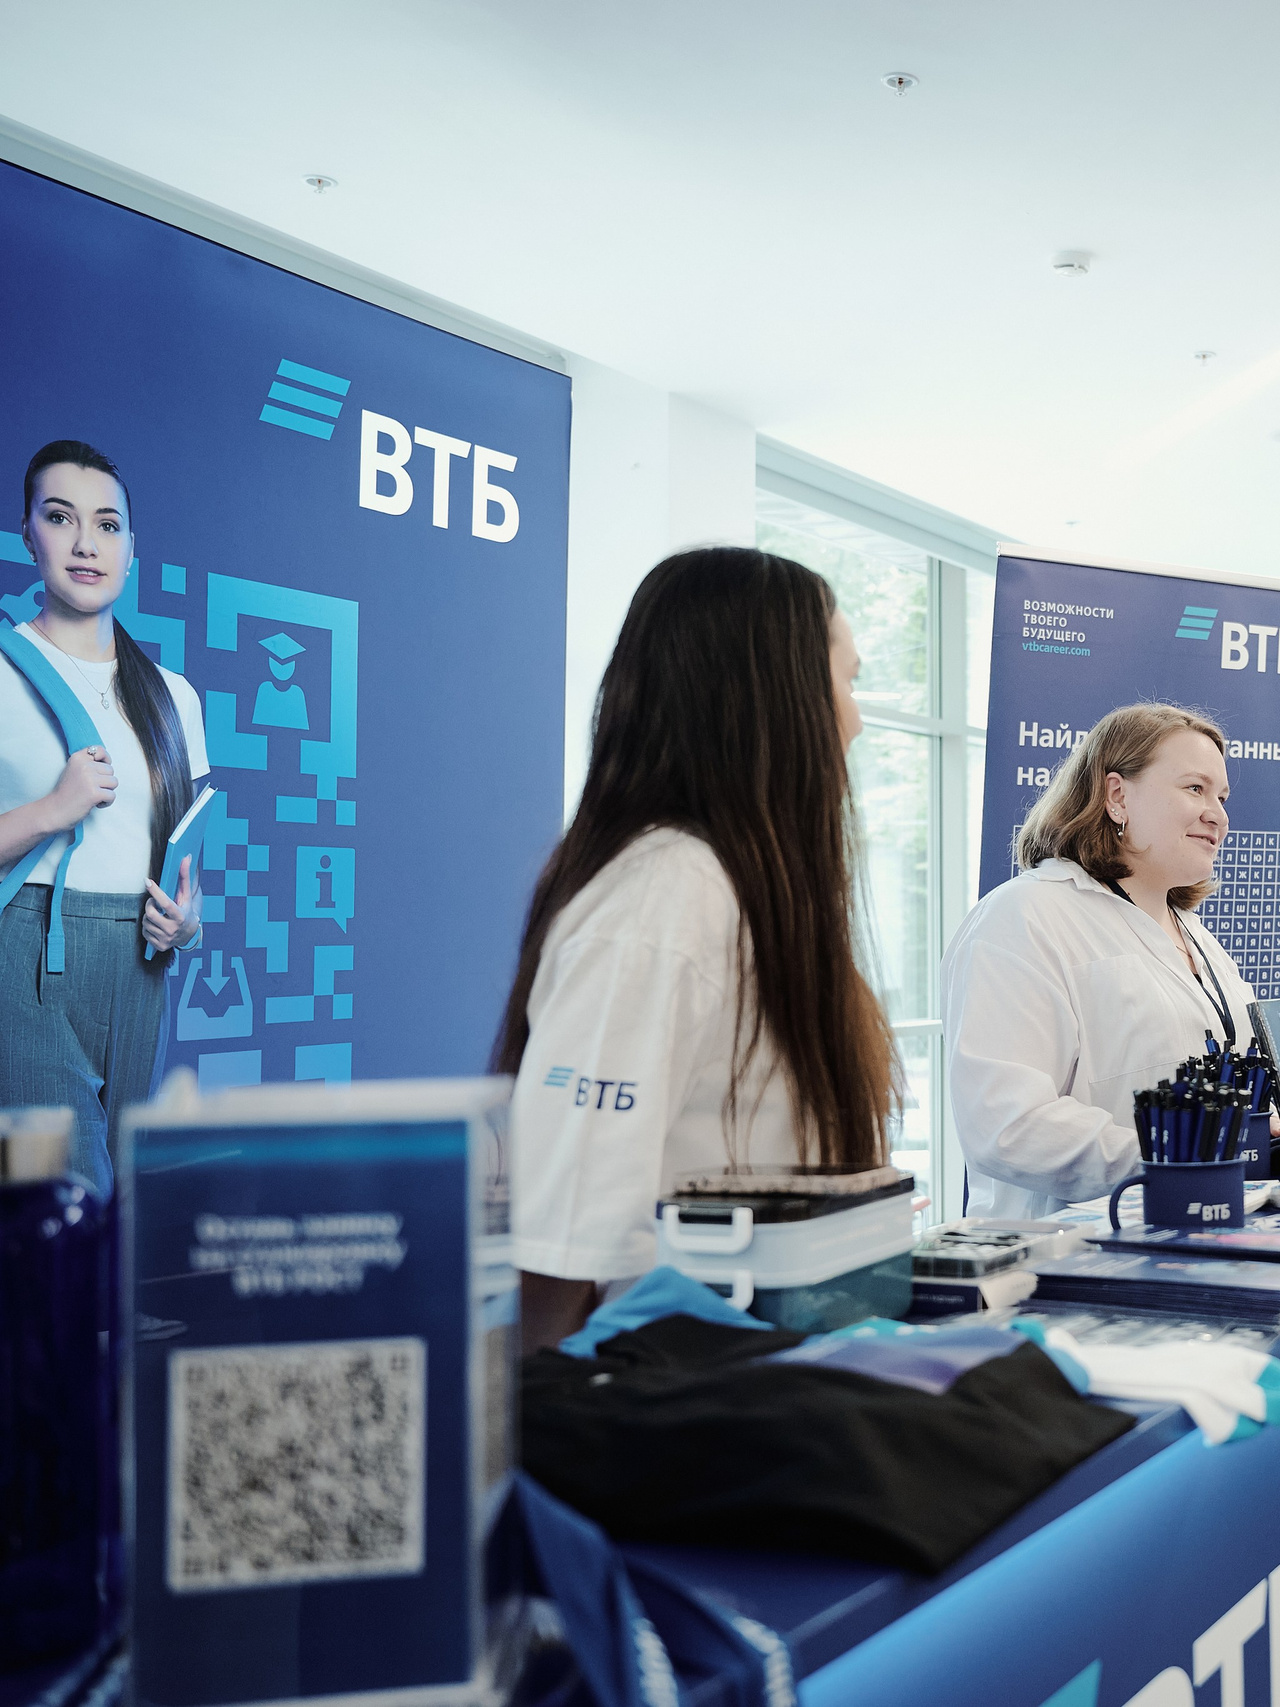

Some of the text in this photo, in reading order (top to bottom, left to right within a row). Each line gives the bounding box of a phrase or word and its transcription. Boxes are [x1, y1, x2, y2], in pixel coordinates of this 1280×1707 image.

[359, 408, 520, 543] ВТБ
[1023, 599, 1114, 619] ВОЗМОЖНОСТИ
[1023, 613, 1067, 627] ТВОЕГО
[1022, 627, 1086, 642] БУДУЩЕГО
[1022, 641, 1091, 656] vtbcareer.com
[1019, 721, 1089, 753] Найд
[575, 1077, 637, 1111] ВТБ
[1242, 1149, 1259, 1161] ТБ
[1202, 1203, 1231, 1221] ВТБ
